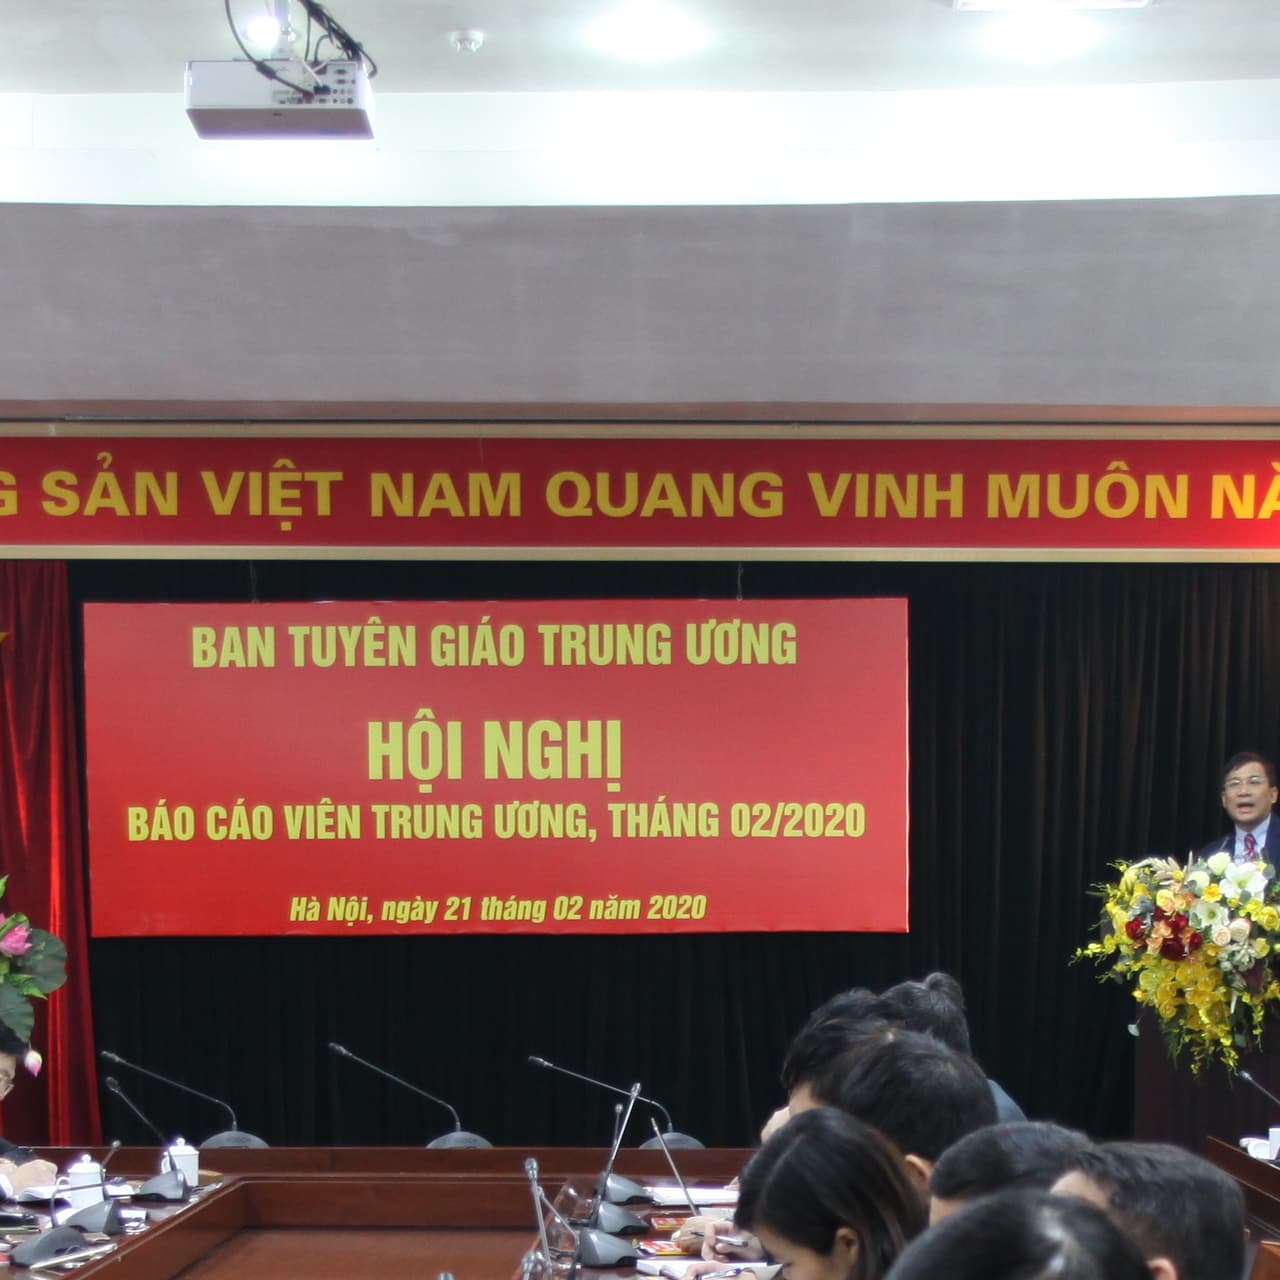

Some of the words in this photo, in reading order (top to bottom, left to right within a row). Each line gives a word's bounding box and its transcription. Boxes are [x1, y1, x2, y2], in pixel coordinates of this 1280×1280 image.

[41, 452, 178, 517] SẢN
[202, 459, 343, 531] VIỆT
[371, 472, 521, 517] NAM
[546, 471, 783, 518] QUANG
[808, 472, 964, 519] VINH
[987, 460, 1189, 519] MUÔN
[192, 625, 276, 669] BAN
[287, 616, 417, 668] TUYÊN
[430, 616, 525, 668] GIÁO
[538, 623, 672, 666] TRUNG
[685, 618, 798, 666] ƯƠNG
[367, 707, 463, 794] HỘI
[483, 719, 622, 793] NGHỊ
[127, 799, 195, 842] BÁO
[206, 797, 274, 841] CÁO
[282, 797, 361, 840] VIÊN
[370, 803, 484, 840] TRUNG
[493, 799, 598, 843] ƯƠNG,
[607, 795, 720, 838] THÁNG
[729, 800, 867, 839] 02/2020
[289, 895, 321, 922] Hà
[326, 895, 374, 927] Nội,
[380, 895, 439, 925] ngày
[443, 896, 472, 921] 21
[480, 895, 548, 924] tháng
[552, 895, 584, 921] 02
[588, 894, 642, 921] năm
[646, 894, 708, 920] 2020
